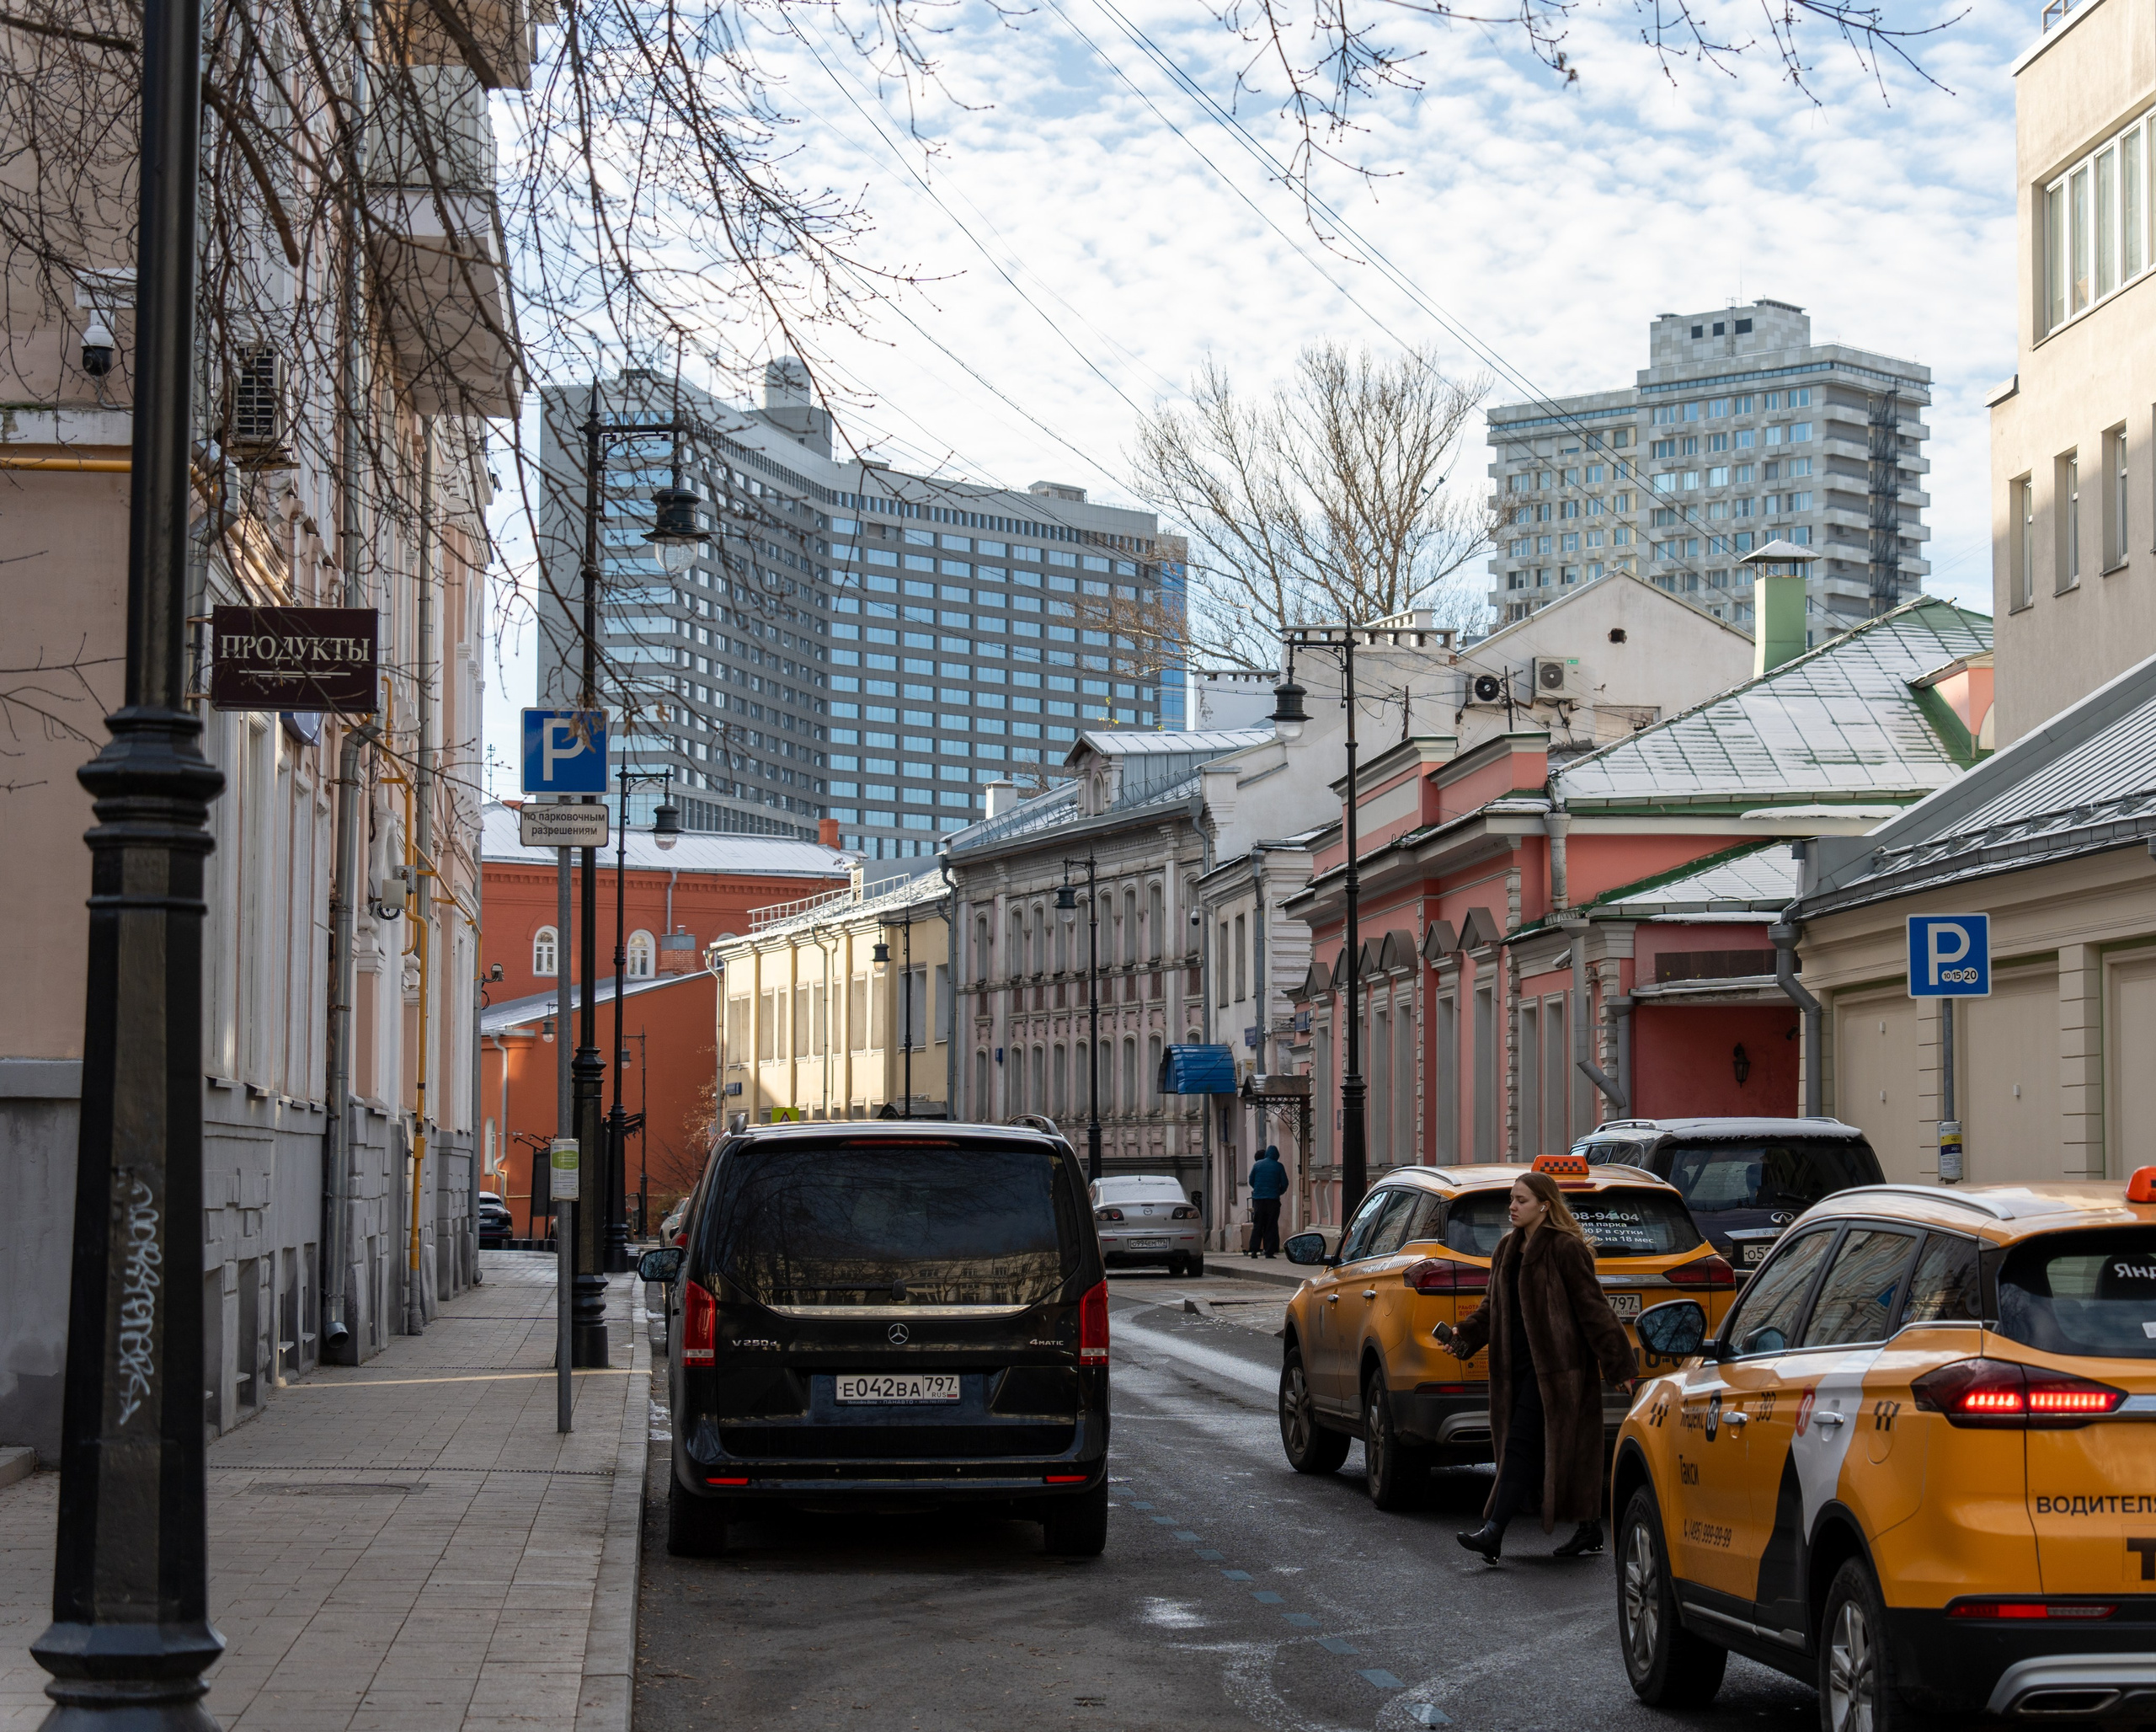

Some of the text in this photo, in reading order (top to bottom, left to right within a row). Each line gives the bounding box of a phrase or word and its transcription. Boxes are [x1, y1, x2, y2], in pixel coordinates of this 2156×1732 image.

[220, 634, 371, 666] ПРОДУКТЫ
[542, 718, 588, 782] P
[538, 812, 606, 824] парковочным
[531, 826, 598, 837] разрешениям
[1927, 922, 1971, 986] P
[1952, 971, 1961, 980] 15
[1963, 970, 1977, 981] 20
[1570, 1211, 1640, 1221] 08-9404
[1609, 1297, 1635, 1310] 797
[843, 1377, 955, 1398] Е042ВА 797
[1706, 1399, 1719, 1431] Go
[1798, 1393, 1812, 1428] Я
[1678, 1454, 1700, 1486] Такси
[2036, 1495, 2156, 1516] ВОДИТЕЛ
[1701, 1523, 1732, 1548] 999-99-99
